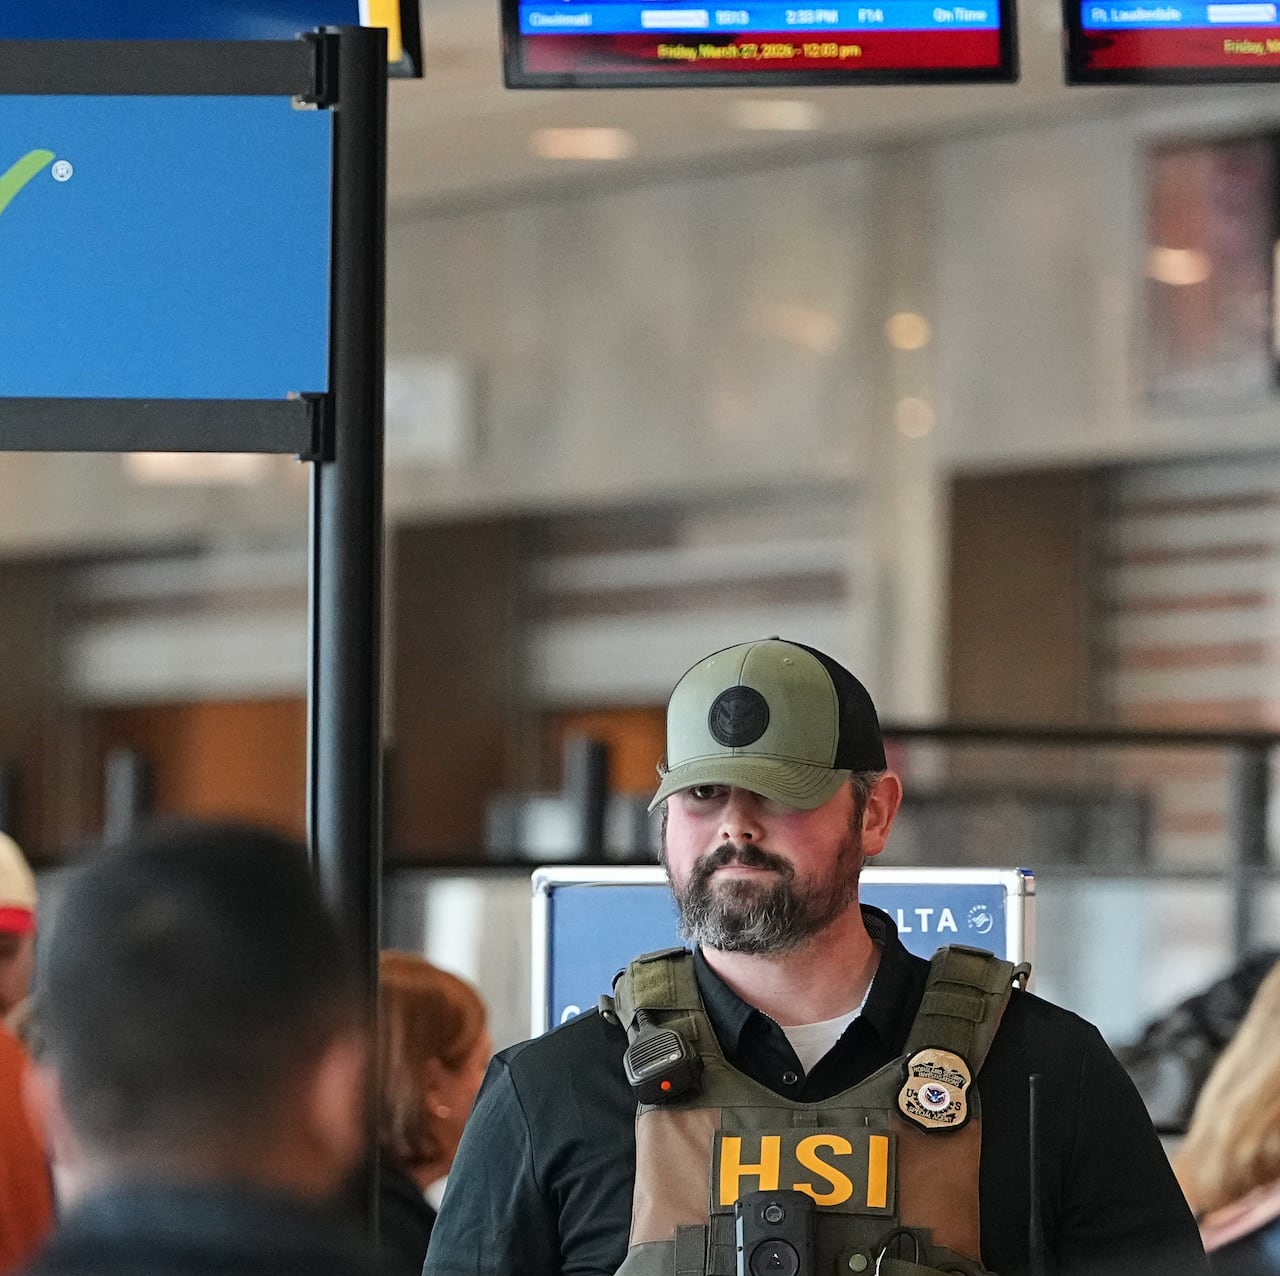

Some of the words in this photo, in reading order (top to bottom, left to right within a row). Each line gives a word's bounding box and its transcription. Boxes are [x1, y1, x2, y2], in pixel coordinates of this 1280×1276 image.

[698, 42, 738, 59] March
[839, 44, 862, 60] pm
[881, 907, 959, 933] LTA
[719, 1133, 889, 1208] HSI
